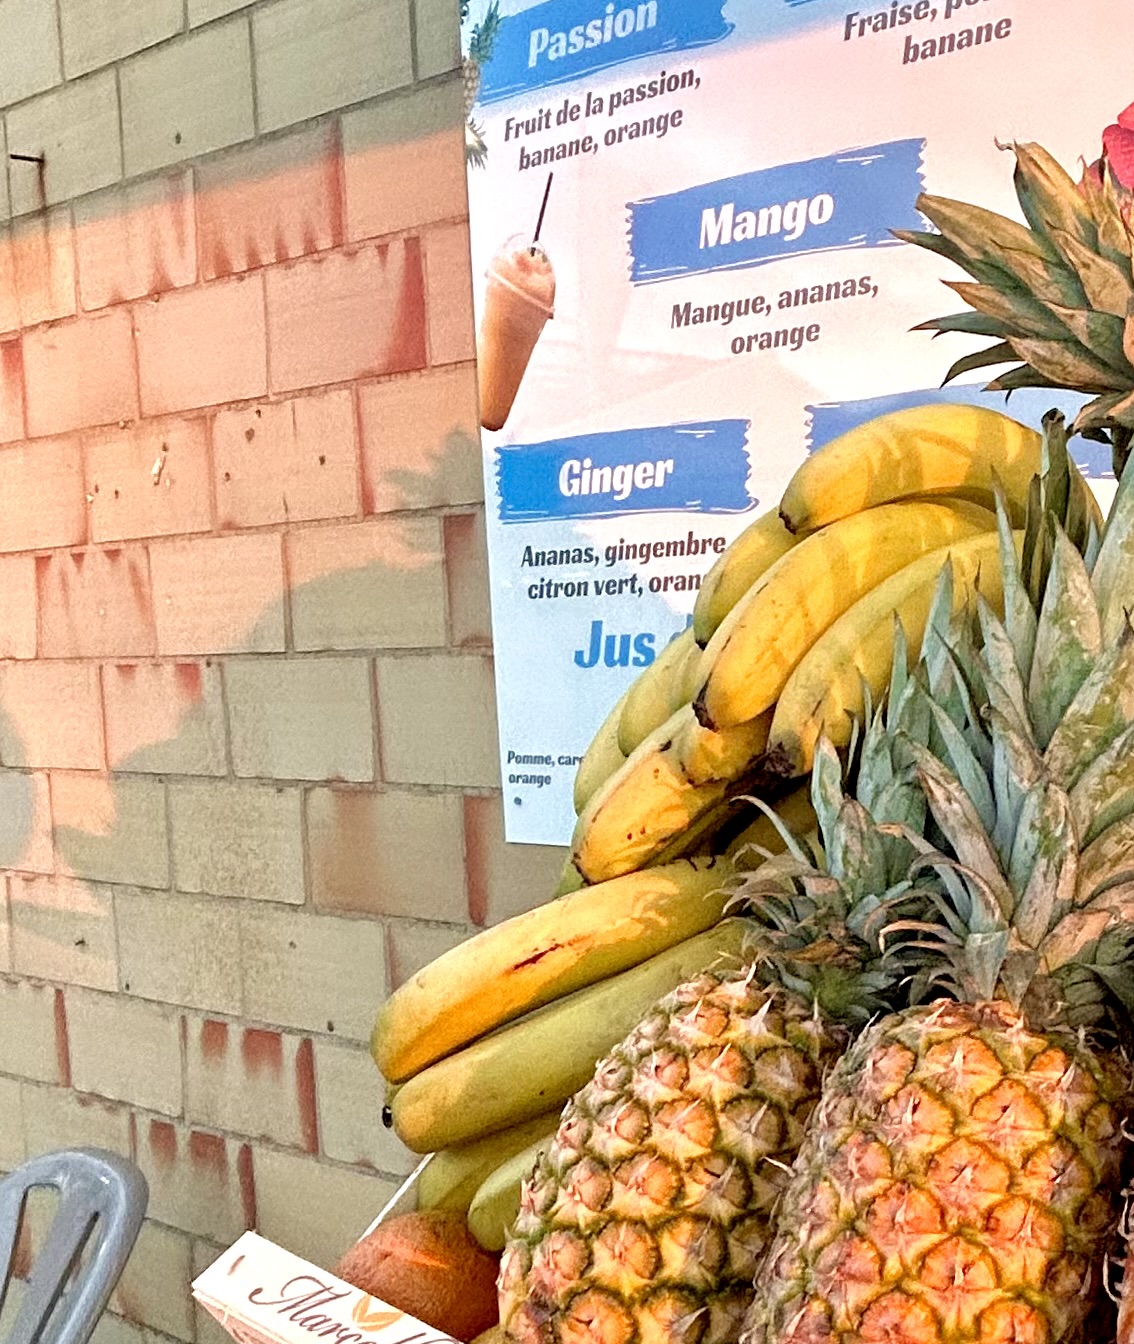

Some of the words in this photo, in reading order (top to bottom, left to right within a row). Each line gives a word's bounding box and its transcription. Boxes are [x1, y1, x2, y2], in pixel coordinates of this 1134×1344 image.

[901, 14, 1012, 66] banane
[505, 108, 552, 141] Fruit
[556, 99, 581, 127] de
[585, 92, 603, 118] la
[609, 69, 700, 116] passion,
[519, 135, 598, 171] banane,
[604, 109, 683, 146] orange
[698, 192, 834, 251] Mango
[670, 292, 772, 330] Mangue,
[776, 275, 879, 312] ananas,
[730, 321, 821, 355] orange
[557, 457, 675, 498] Ginger
[521, 545, 600, 567] Ananas,
[604, 531, 726, 567] gingembre
[528, 577, 589, 600] citron
[594, 573, 644, 598] vert,
[574, 620, 656, 668] Jus
[507, 750, 555, 767] Pomme,
[558, 756, 586, 766] car
[509, 774, 551, 788] orange
